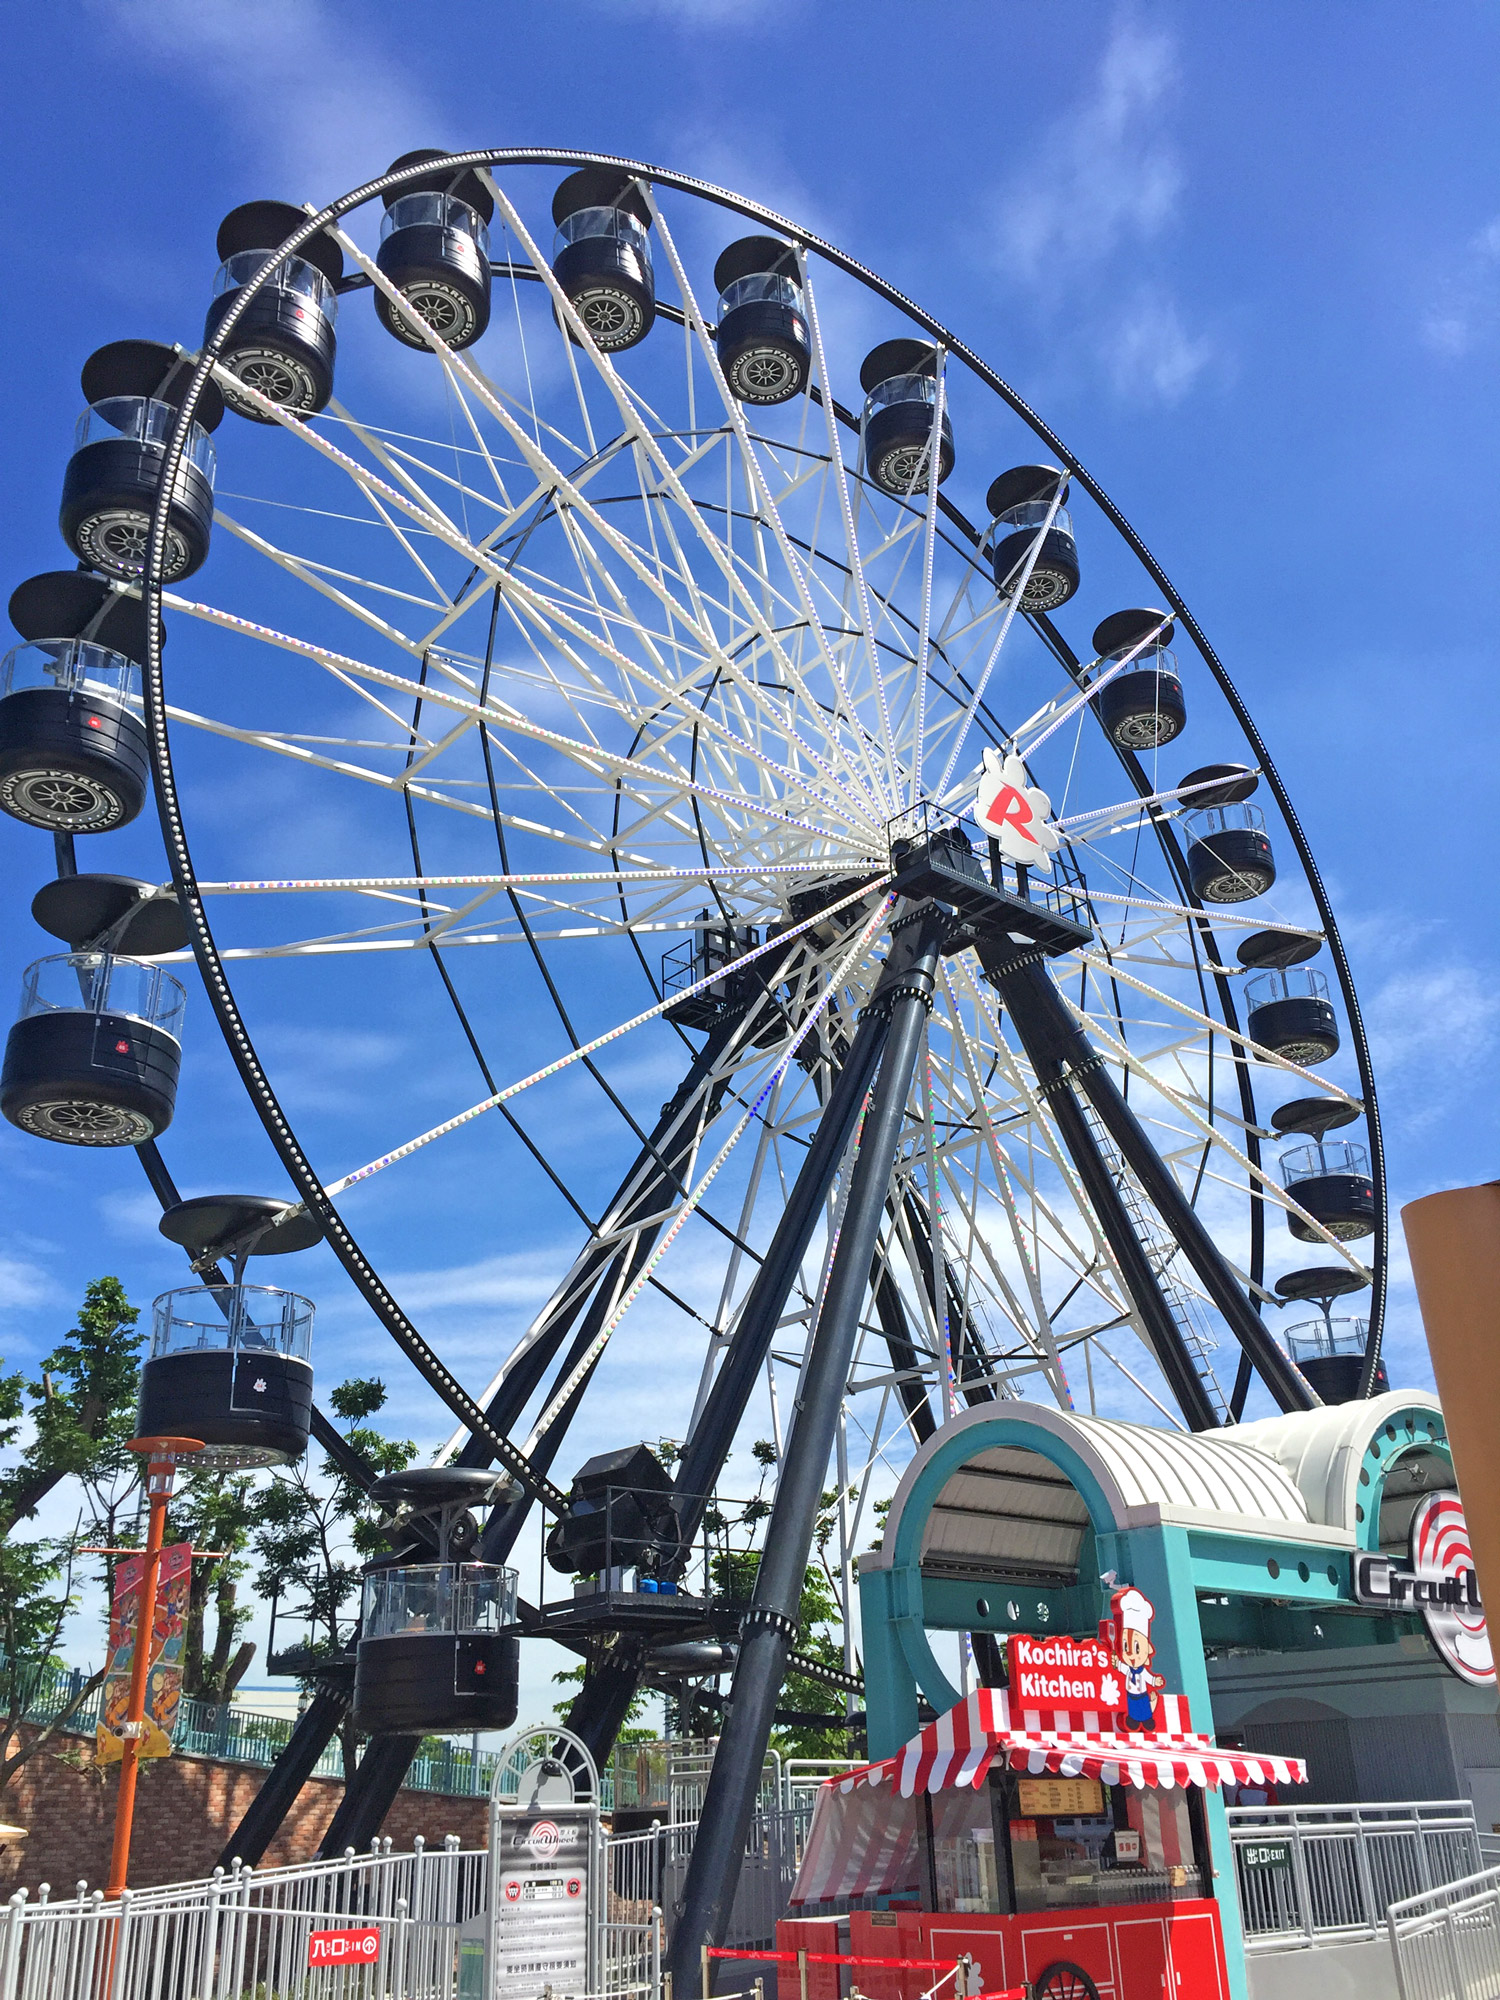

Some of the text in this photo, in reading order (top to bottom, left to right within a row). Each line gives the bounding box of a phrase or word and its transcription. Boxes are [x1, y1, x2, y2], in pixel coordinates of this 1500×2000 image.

[432, 283, 467, 305] PARK
[605, 289, 636, 308] PARK
[263, 351, 304, 375] PARK
[732, 351, 754, 386] CIRCUIT
[774, 349, 798, 370] PARK
[749, 383, 794, 401] SUZUKA
[881, 449, 900, 480] CIRCUIT
[130, 513, 176, 538] PAK
[80, 517, 101, 563] CIRCUIT
[49, 770, 104, 791] PARK
[2, 776, 32, 818] CIRCUIT
[60, 806, 120, 830] SUZUKA
[986, 780, 1040, 846] R
[22, 1105, 53, 1136] CIRCUIT
[72, 1101, 129, 1116] PARK
[83, 1126, 146, 1145] SUZUKA
[1018, 1640, 1109, 1668] Kochira's
[1020, 1673, 1096, 1699] Kitchen
[1270, 1849, 1285, 1860] EXIT
[352, 1941, 361, 1952] IN
